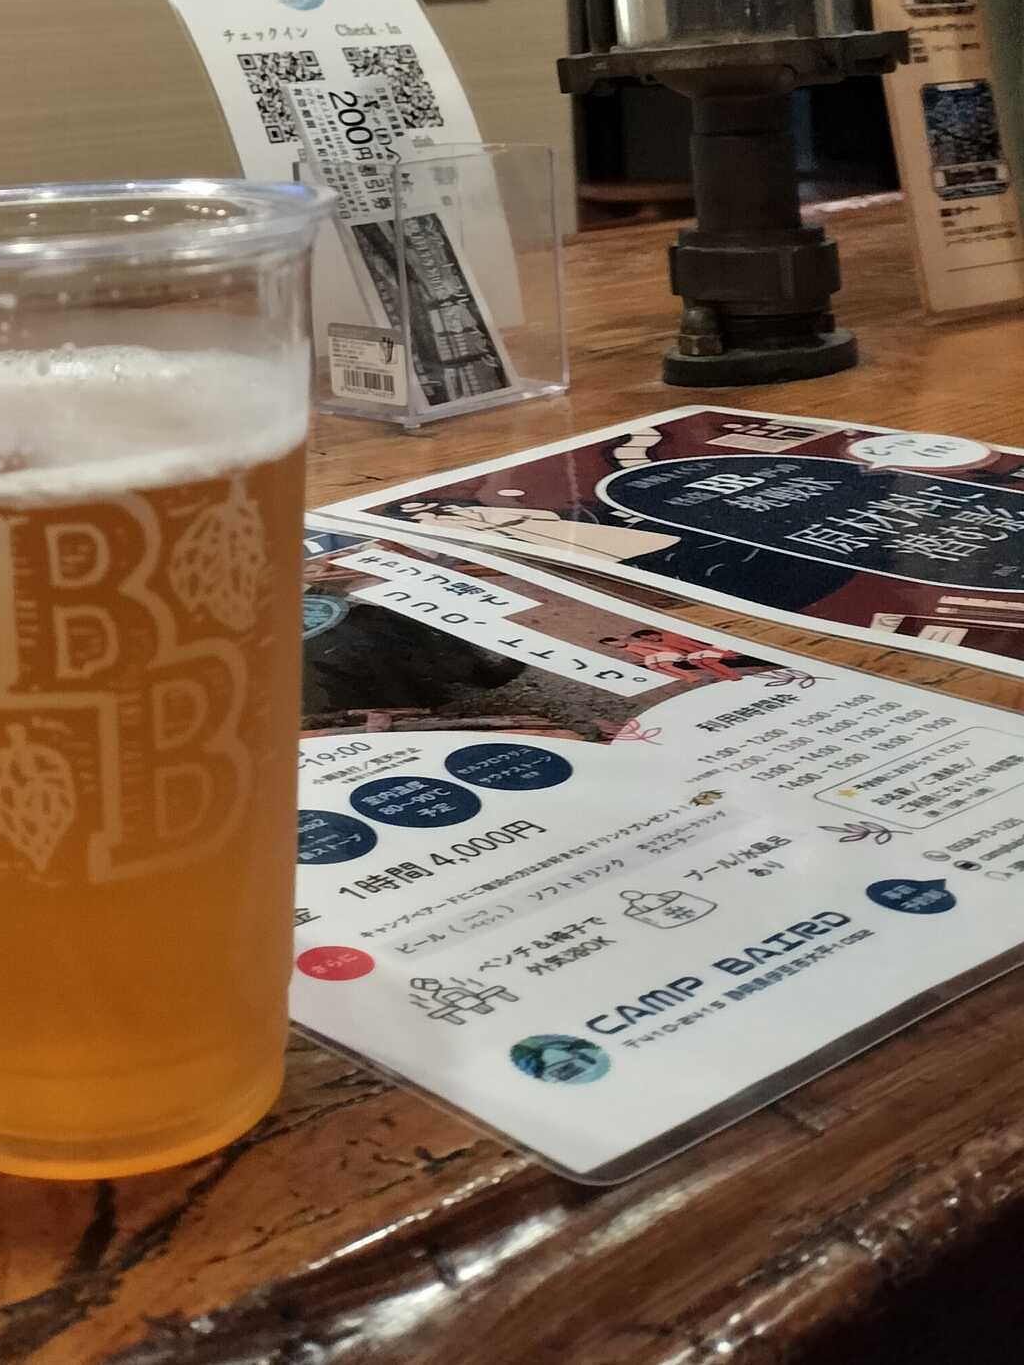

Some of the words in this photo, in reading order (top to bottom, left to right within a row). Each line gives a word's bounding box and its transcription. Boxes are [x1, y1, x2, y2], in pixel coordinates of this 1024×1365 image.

[328, 90, 392, 211] 200円割引券
[785, 485, 986, 554] 原材料に
[881, 504, 1024, 563] 潜む影
[695, 692, 802, 733] 利用時間枠
[338, 861, 435, 900] 1時間
[429, 819, 548, 867] 4,000円
[527, 858, 625, 903] ソフトドリンク
[585, 975, 705, 1036] CAMP
[711, 910, 852, 976] BAIRD
